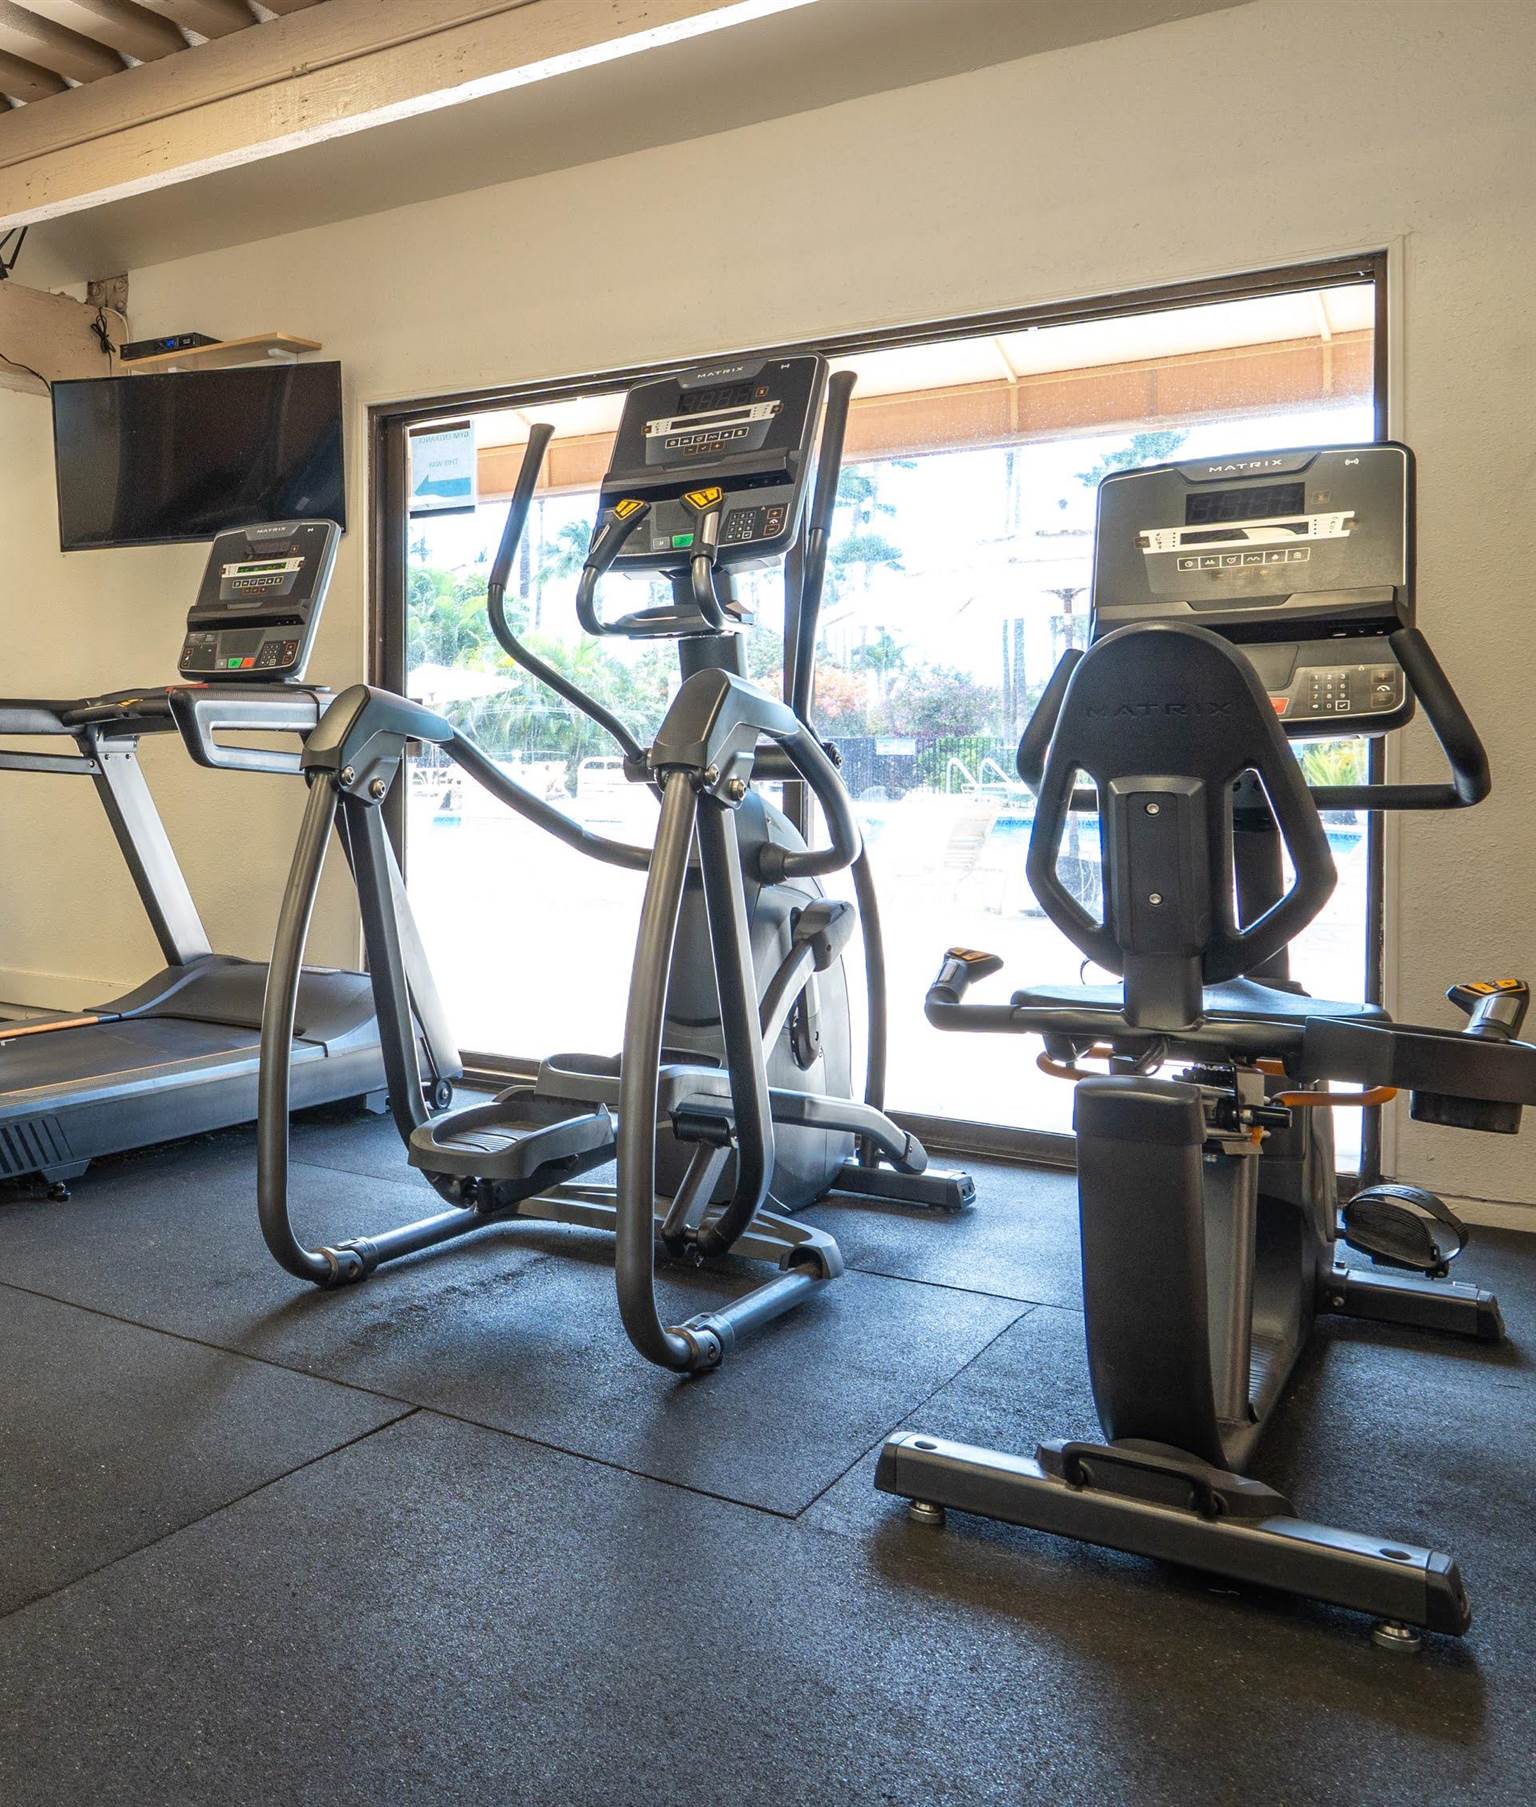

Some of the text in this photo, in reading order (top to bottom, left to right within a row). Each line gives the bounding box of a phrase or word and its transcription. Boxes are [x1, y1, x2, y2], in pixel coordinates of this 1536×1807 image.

[697, 365, 744, 379] MATRIX
[1208, 459, 1283, 473] MATRIX
[1087, 703, 1233, 719] MATRIX
